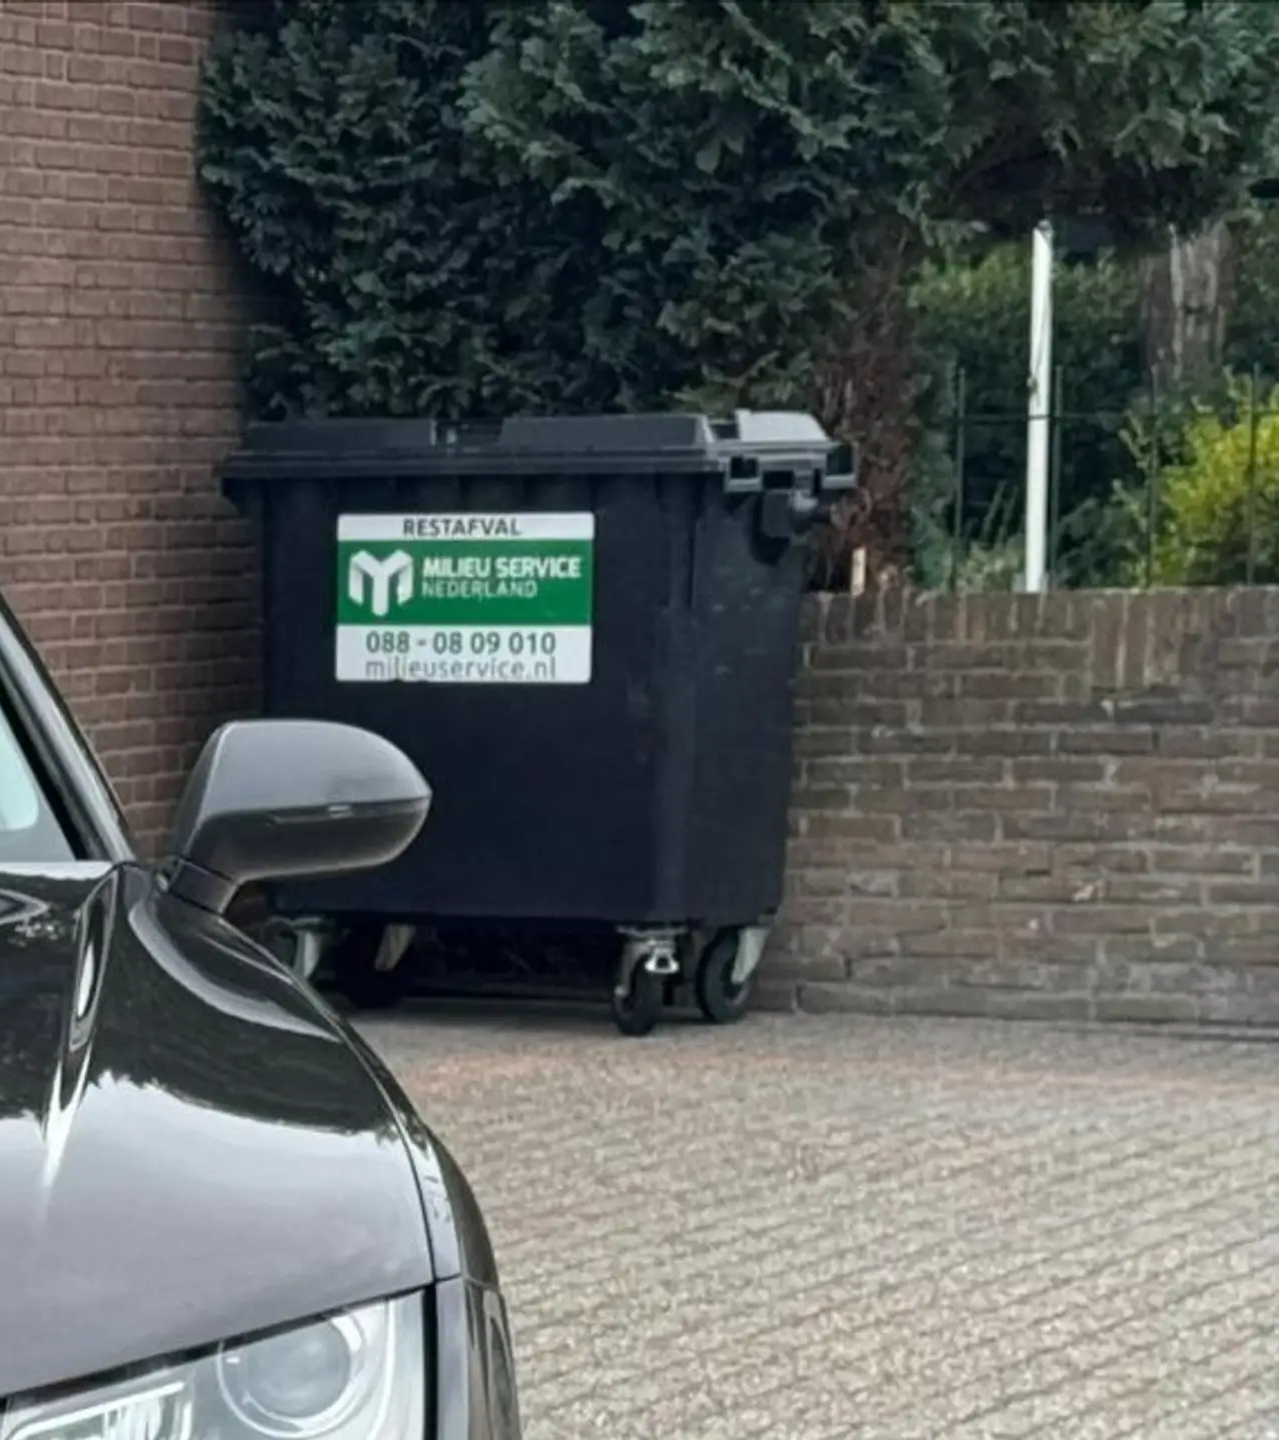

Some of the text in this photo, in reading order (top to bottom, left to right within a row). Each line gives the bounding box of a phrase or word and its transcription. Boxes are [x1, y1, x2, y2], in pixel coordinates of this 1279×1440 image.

[402, 517, 523, 537] RESTAFVAL
[422, 556, 582, 579] MILIEU SERVICE
[421, 580, 538, 598] NEDERLAND
[365, 630, 411, 655] 088
[432, 630, 463, 655] 08
[469, 630, 501, 655] 09
[508, 630, 557, 655] 010
[365, 656, 557, 680] milieuservice.nl
